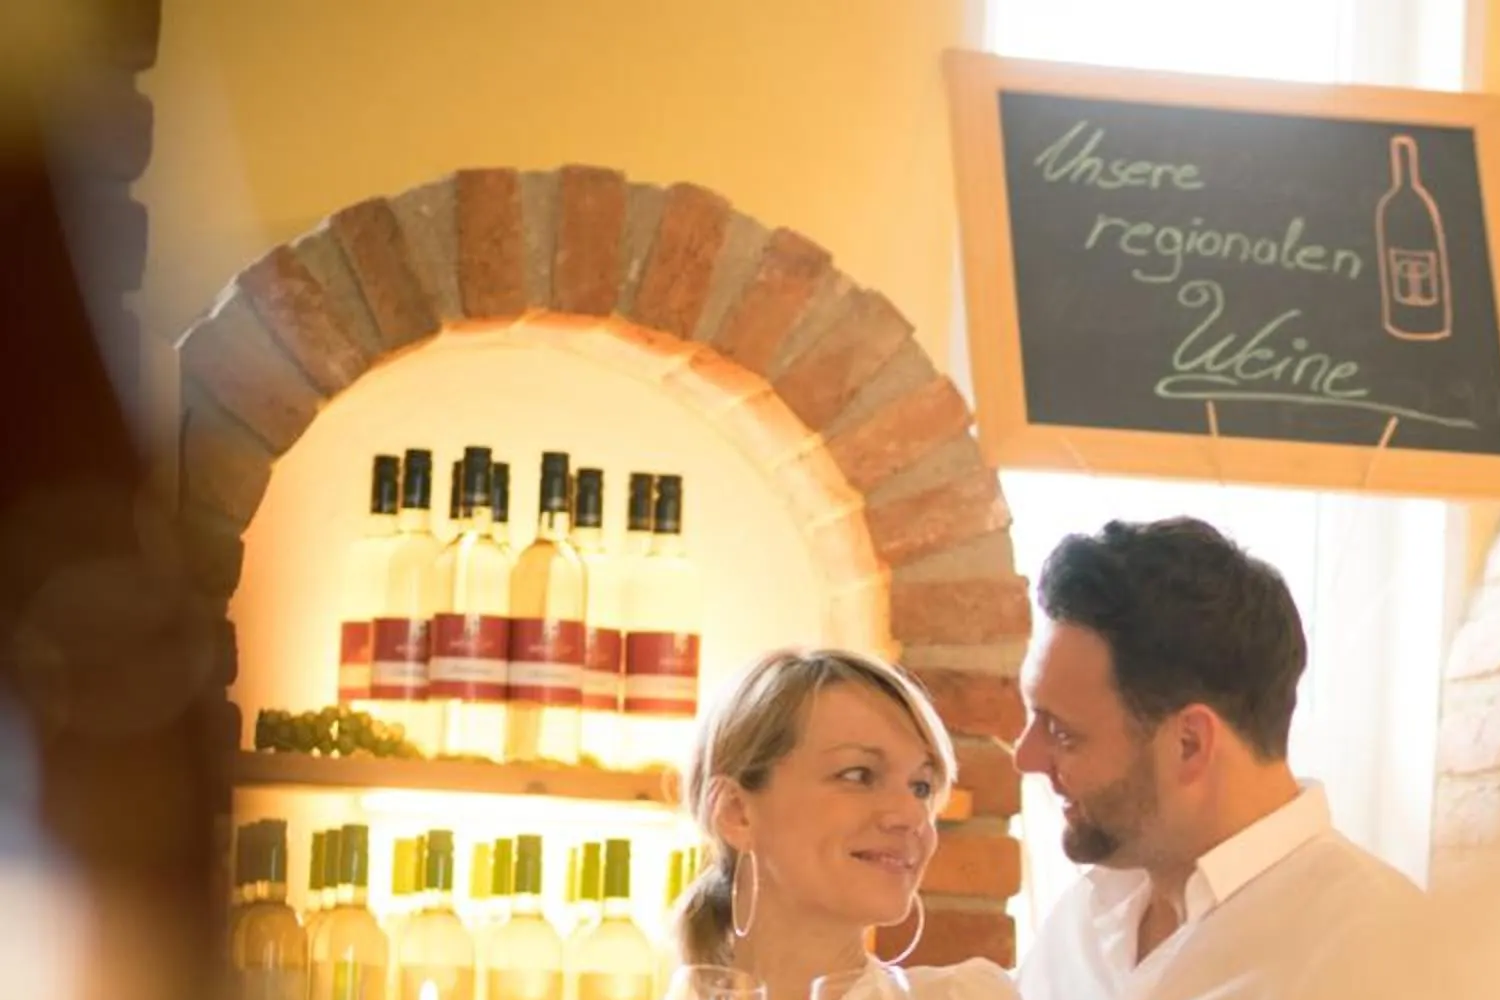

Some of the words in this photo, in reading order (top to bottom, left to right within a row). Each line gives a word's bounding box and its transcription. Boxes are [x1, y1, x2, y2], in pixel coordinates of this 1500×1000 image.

[1034, 119, 1206, 190] Unsere
[1085, 212, 1363, 282] regionalen
[1171, 280, 1368, 398] Weine
